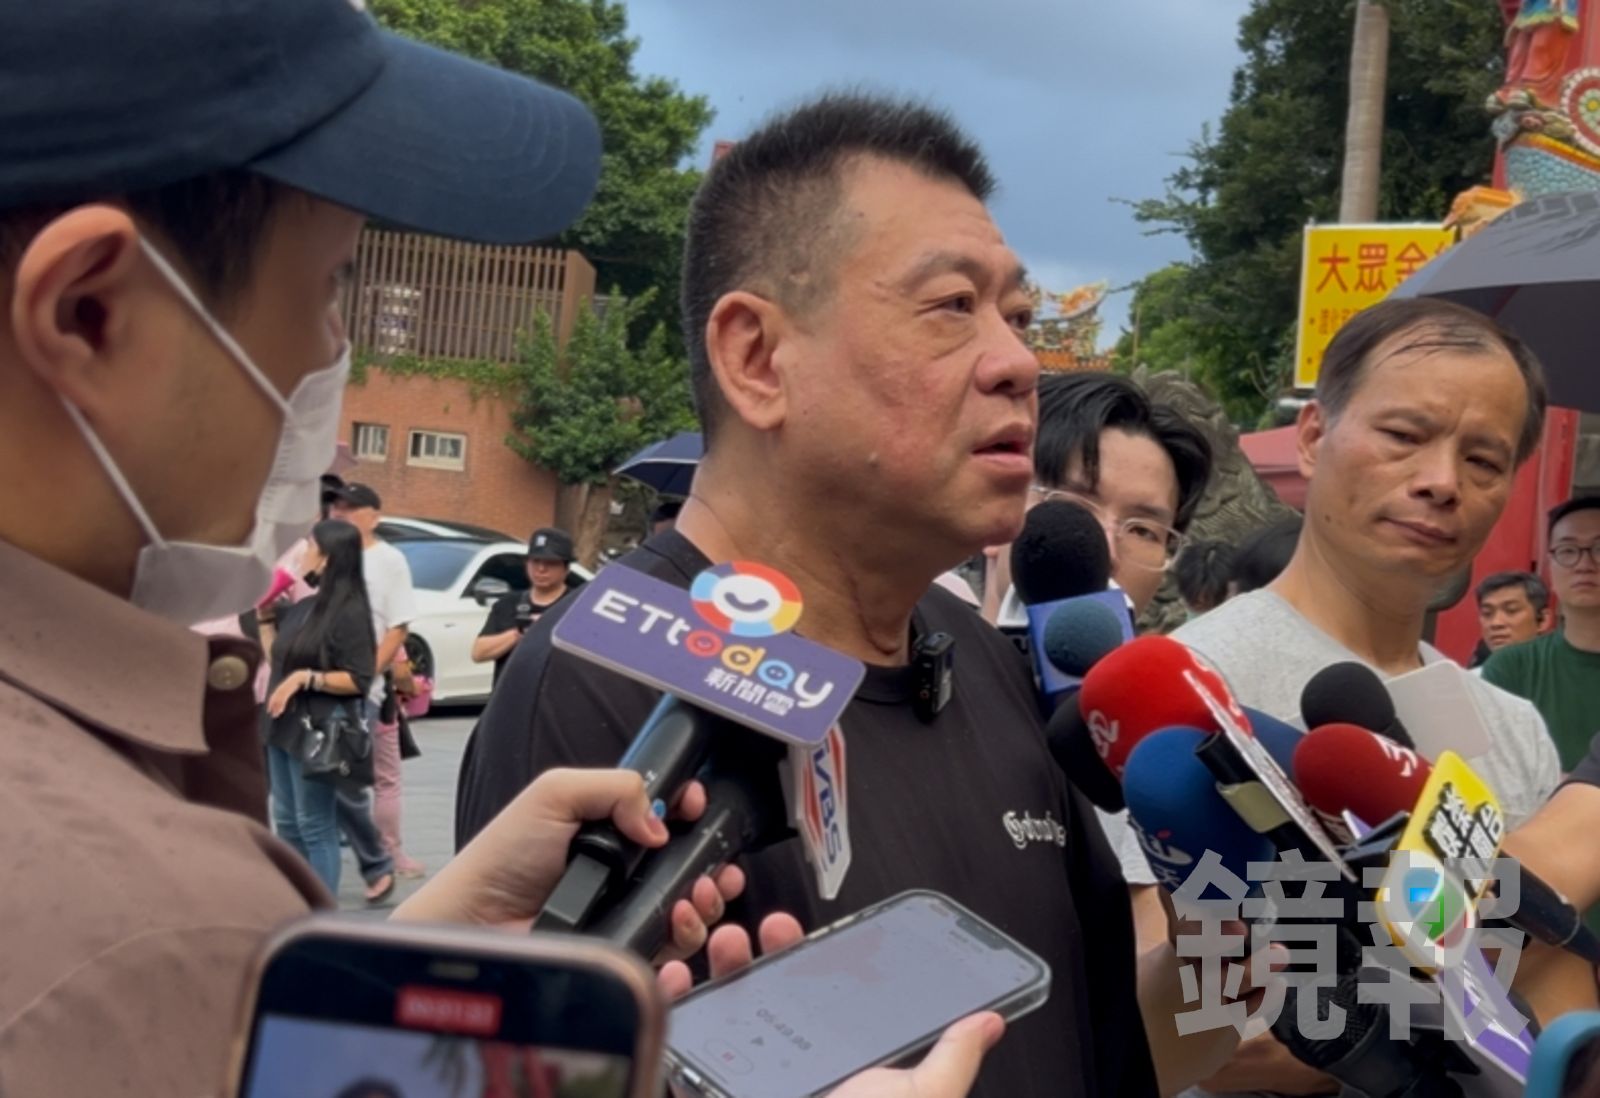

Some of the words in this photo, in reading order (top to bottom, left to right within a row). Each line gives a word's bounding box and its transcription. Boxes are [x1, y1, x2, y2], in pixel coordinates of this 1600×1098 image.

[1316, 242, 1447, 292] 大眾金
[592, 589, 834, 708] ETtoday
[703, 667, 795, 716] 新聞雲
